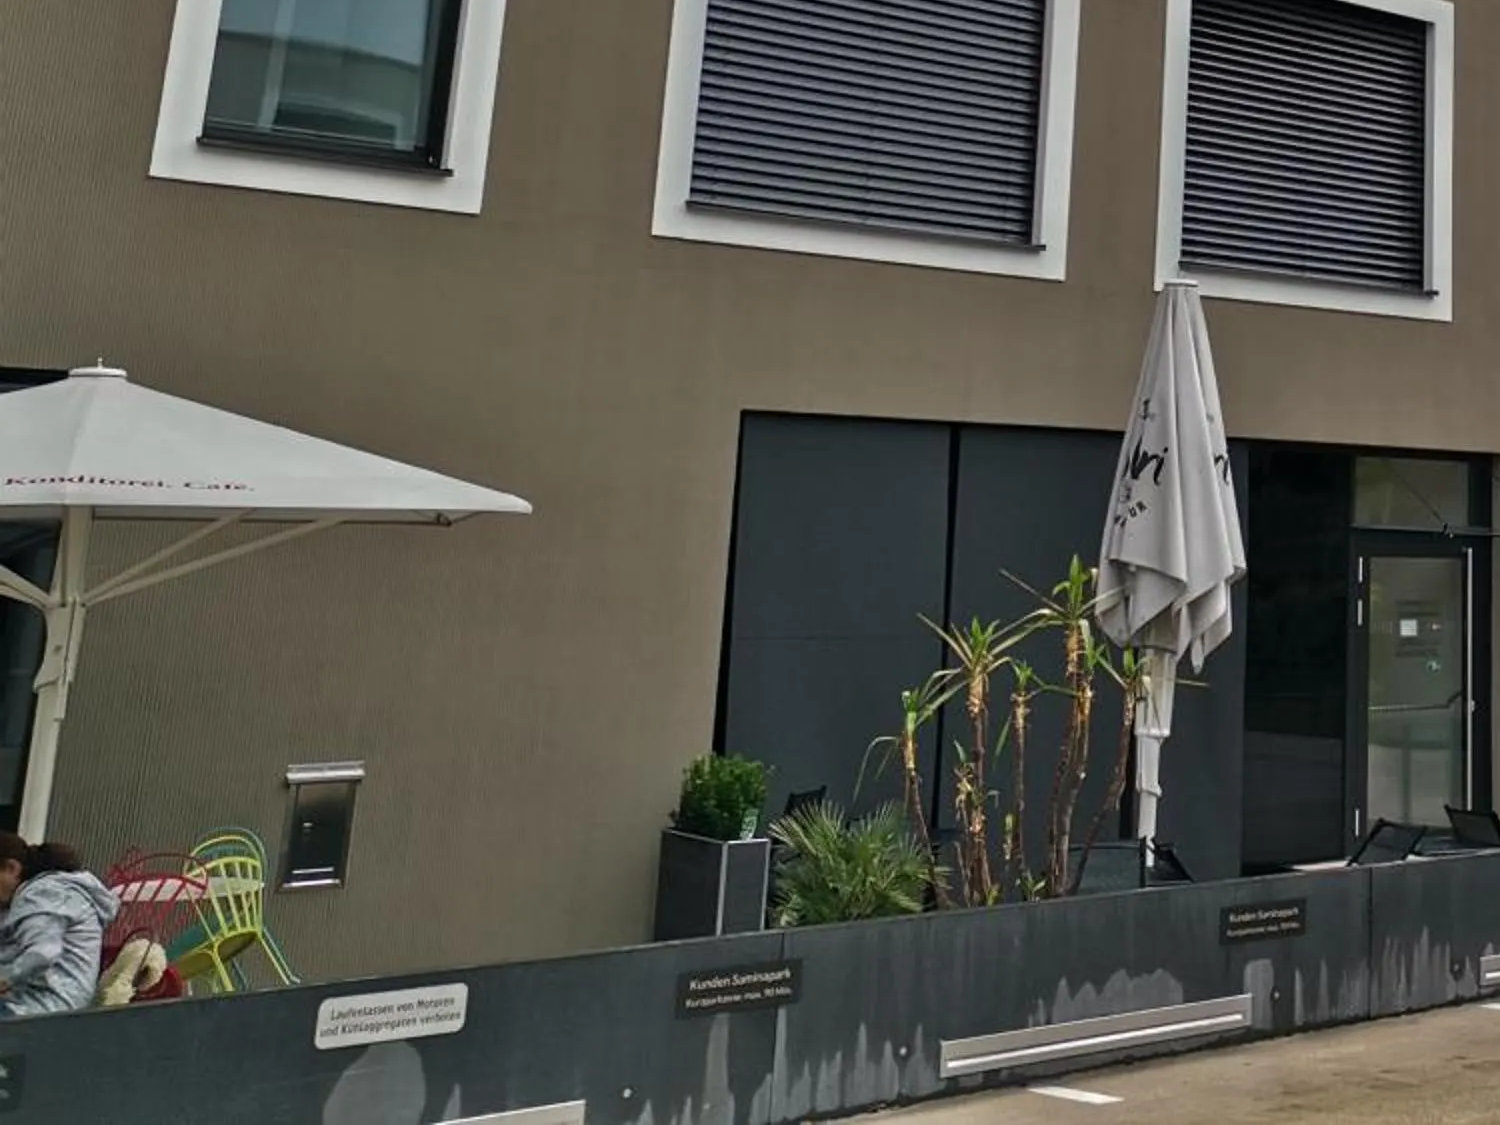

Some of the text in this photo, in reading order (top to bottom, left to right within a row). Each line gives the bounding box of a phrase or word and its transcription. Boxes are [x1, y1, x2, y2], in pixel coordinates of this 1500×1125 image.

[689, 976, 730, 991] Kunden
[330, 996, 456, 1022] Laufenlassen von Motoren
[319, 1025, 339, 1038] und
[420, 1011, 462, 1025] verboten
